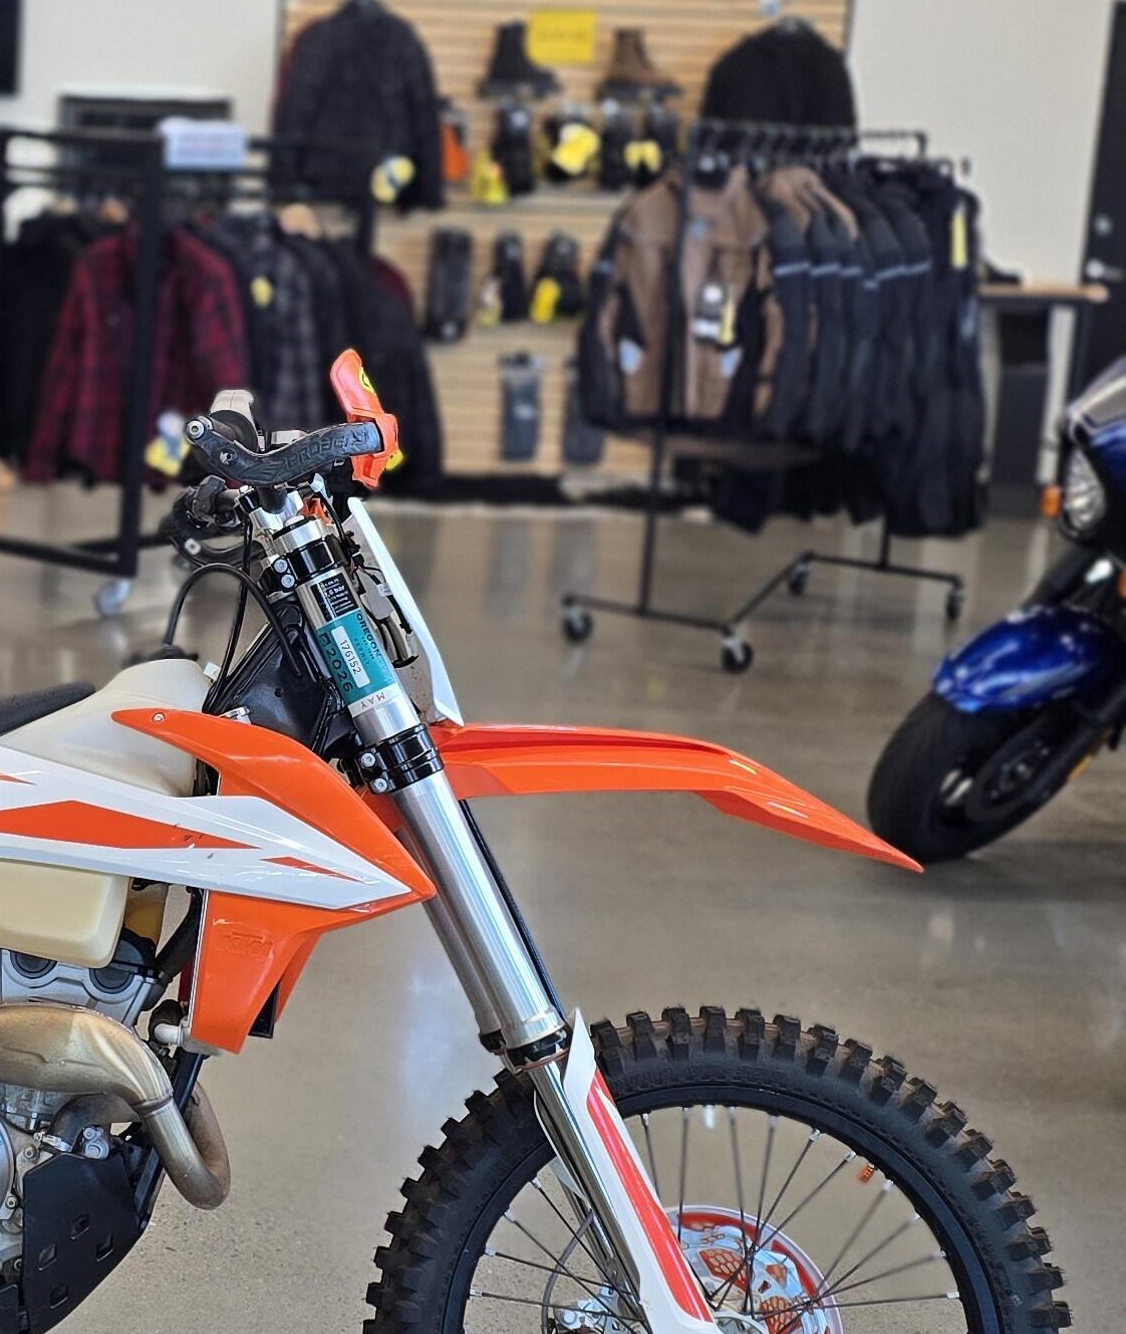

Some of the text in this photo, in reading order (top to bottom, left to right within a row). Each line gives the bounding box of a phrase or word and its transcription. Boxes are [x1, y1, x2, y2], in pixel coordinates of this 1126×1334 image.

[356, 613, 382, 657] OREGON
[325, 646, 354, 693] 2026
[339, 639, 361, 675] 176152
[360, 692, 387, 709] MAY
